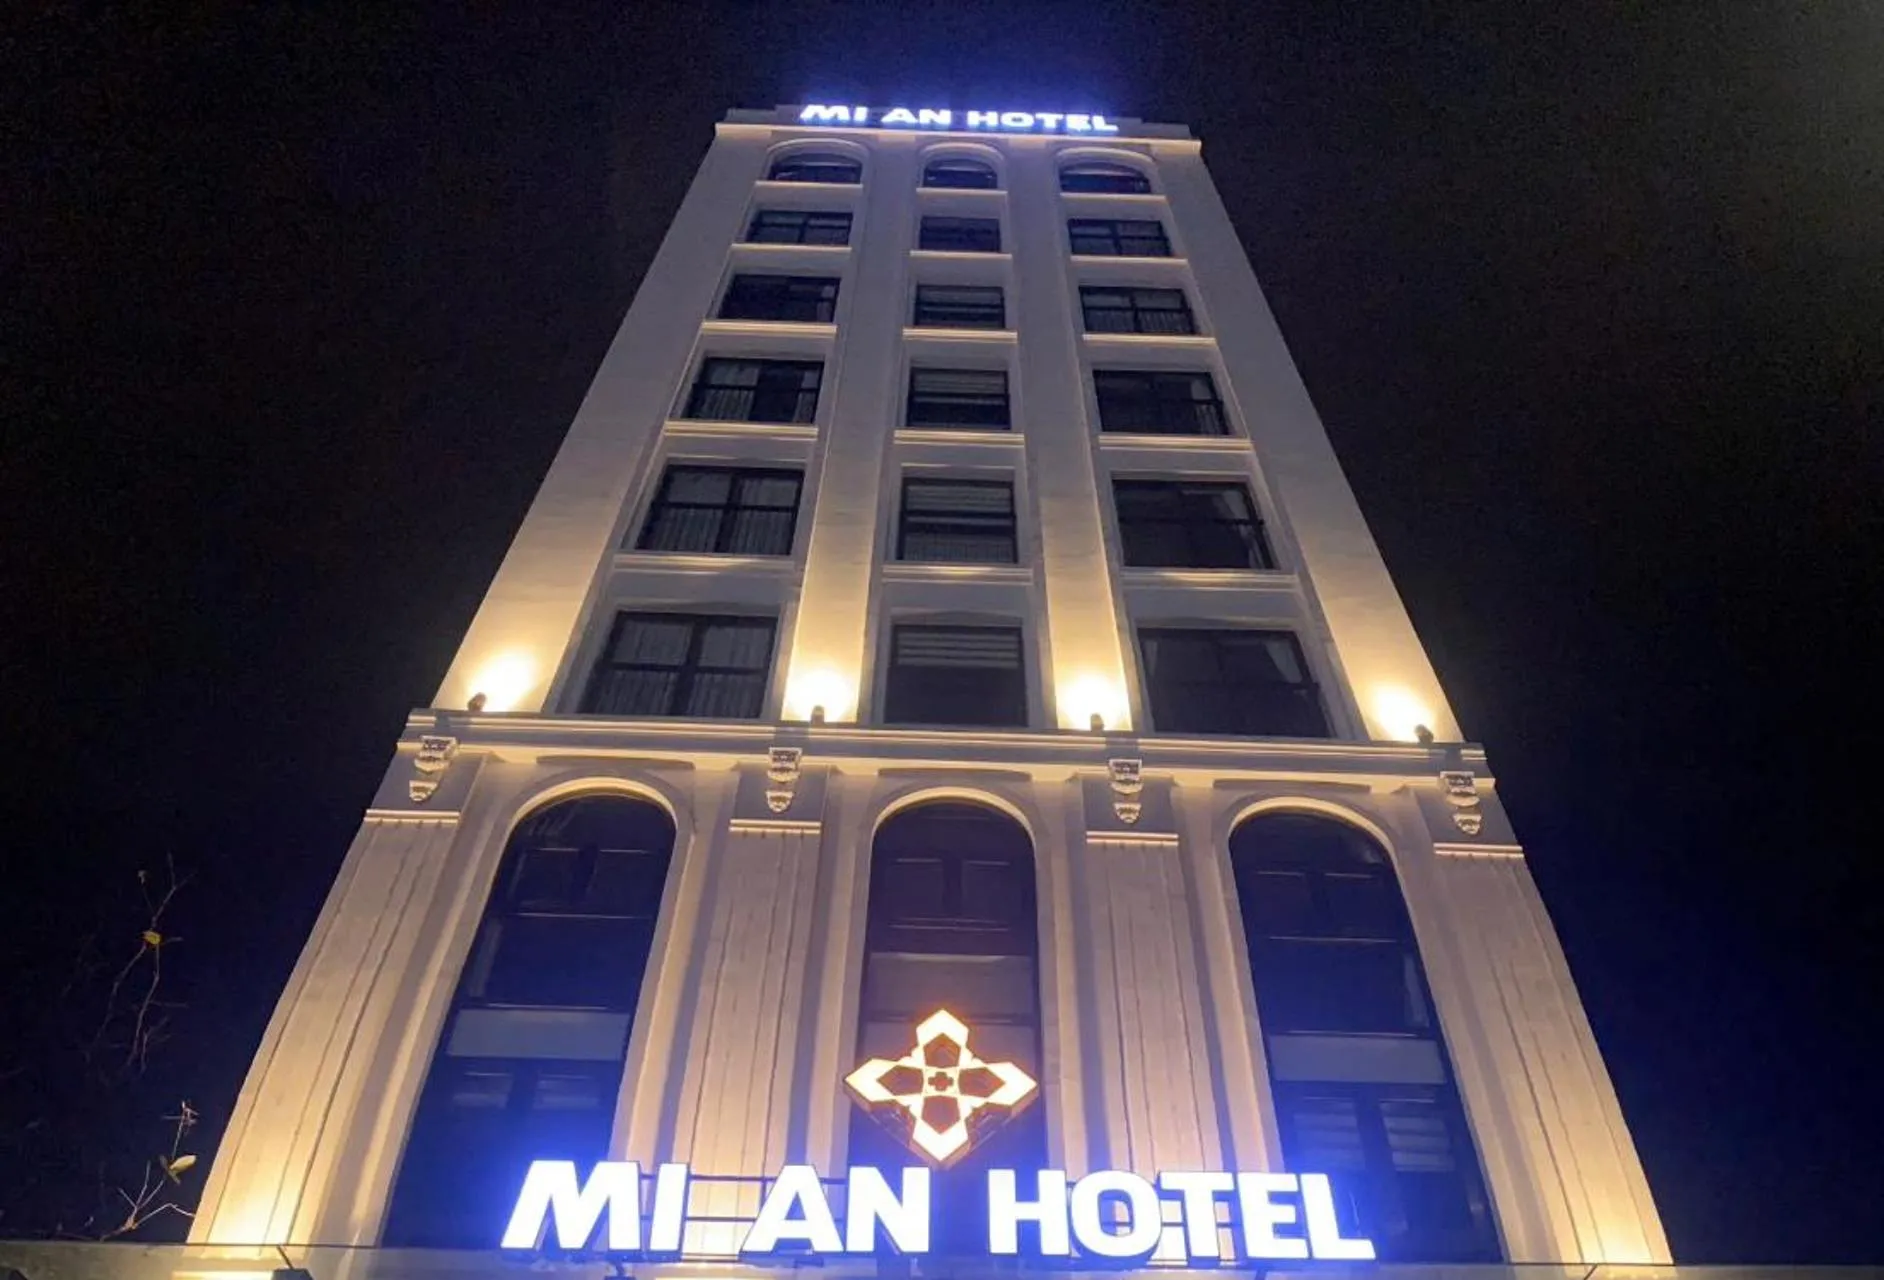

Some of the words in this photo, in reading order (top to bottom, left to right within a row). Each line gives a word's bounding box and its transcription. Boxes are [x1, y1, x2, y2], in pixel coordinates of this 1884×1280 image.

[800, 104, 868, 122] MI
[882, 107, 952, 126] AN
[966, 110, 1119, 132] HOTEL
[501, 1160, 688, 1251] MI
[741, 1164, 930, 1253] AN
[988, 1169, 1376, 1260] HOTEL
